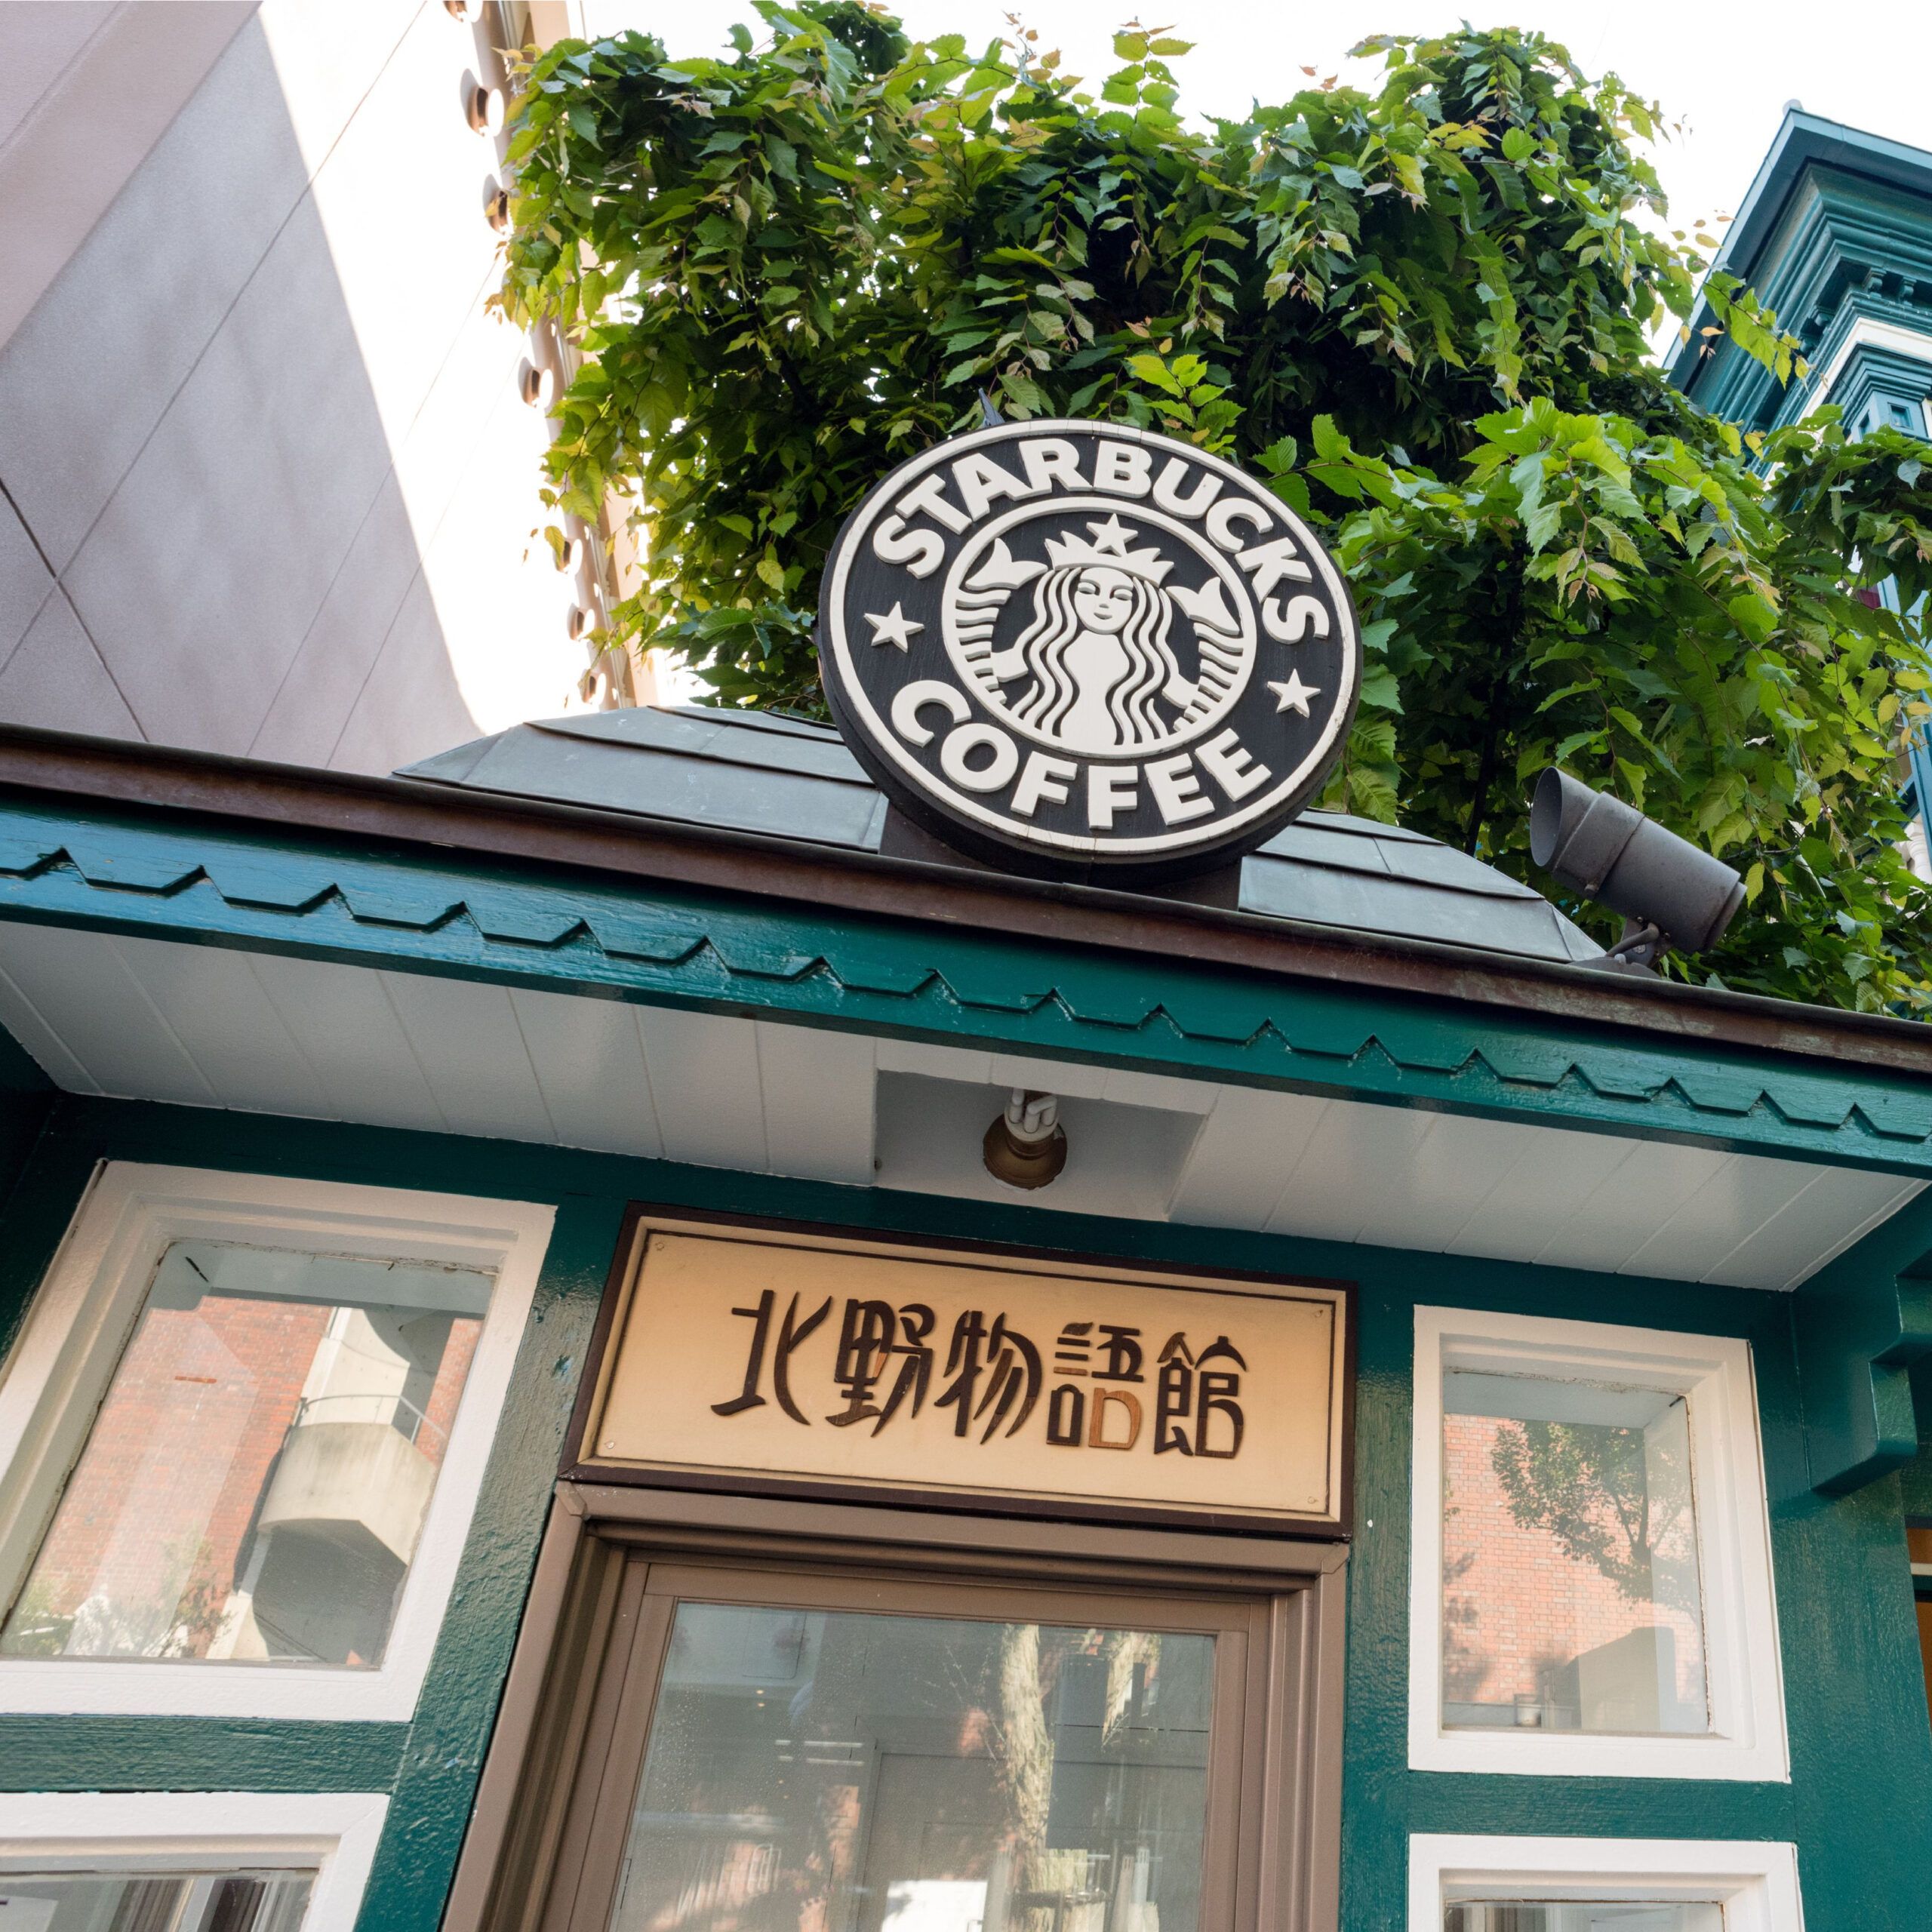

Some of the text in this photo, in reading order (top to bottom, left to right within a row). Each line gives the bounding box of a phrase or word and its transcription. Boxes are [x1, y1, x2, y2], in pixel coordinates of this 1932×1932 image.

[873, 438, 1331, 645] STARBUCKS
[891, 680, 1272, 830] COFFEE
[709, 1288, 1249, 1460] 北野物語館
